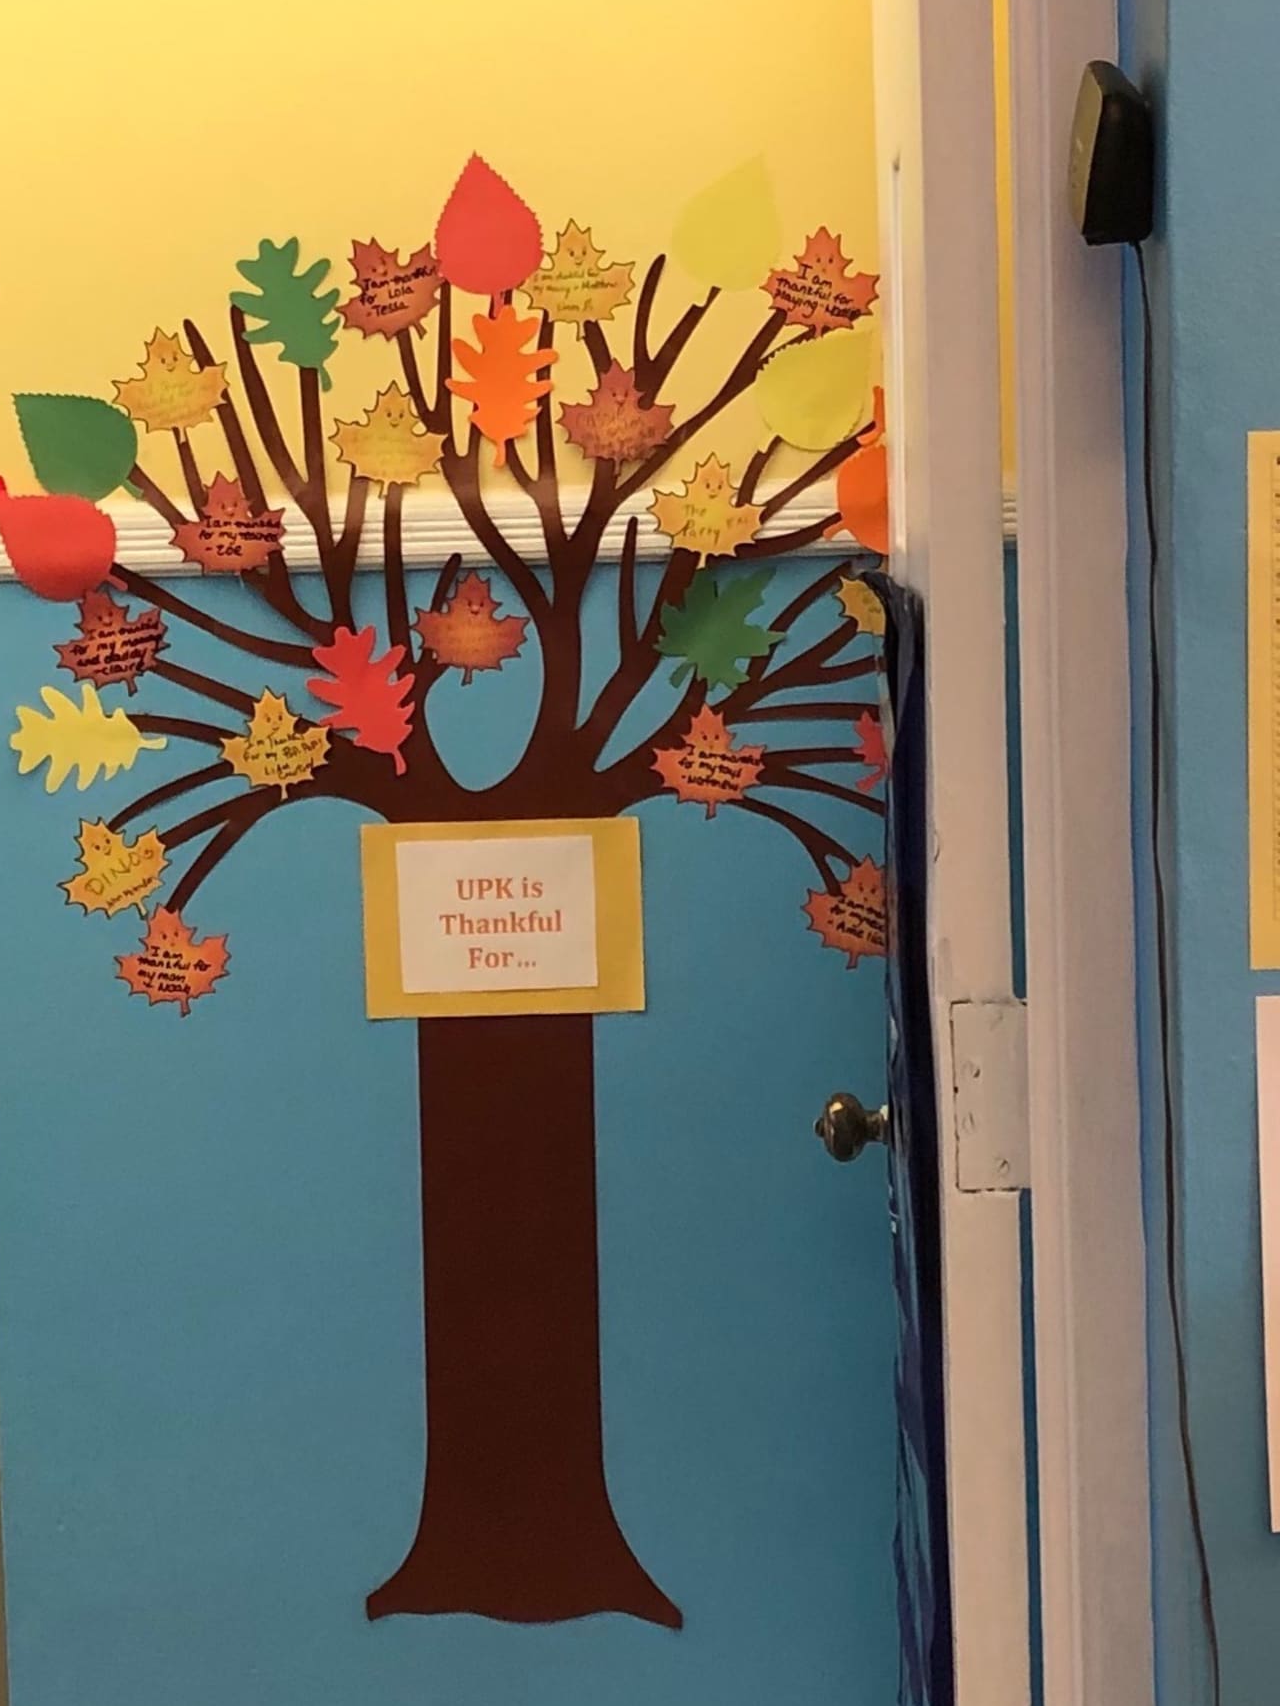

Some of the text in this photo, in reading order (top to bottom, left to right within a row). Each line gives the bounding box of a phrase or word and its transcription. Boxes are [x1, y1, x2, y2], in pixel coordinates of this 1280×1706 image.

[456, 876, 543, 901] UPK is
[439, 909, 562, 935] Thankful
[468, 946, 537, 969] For...
